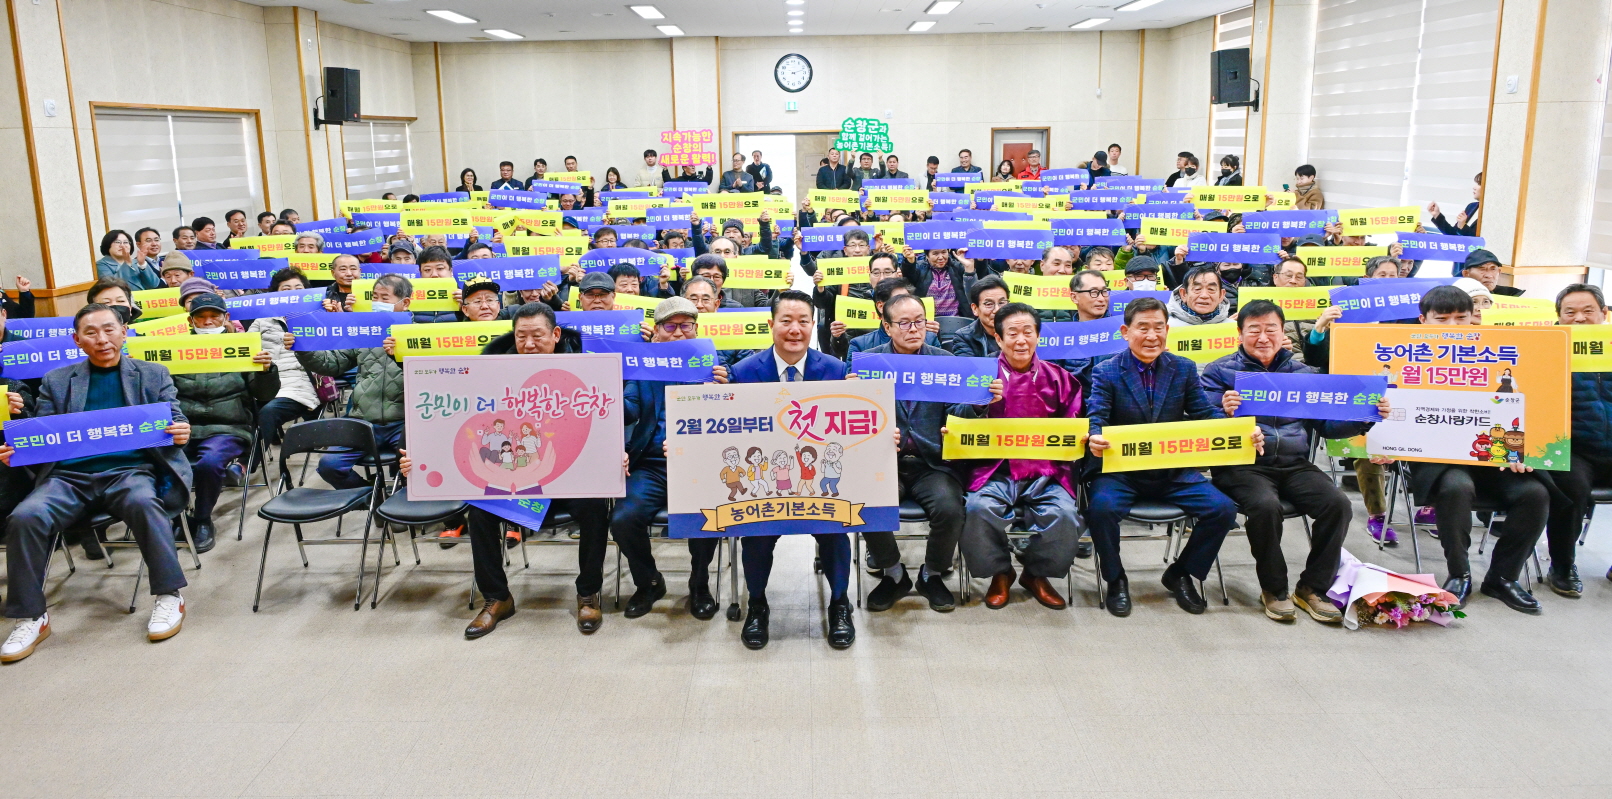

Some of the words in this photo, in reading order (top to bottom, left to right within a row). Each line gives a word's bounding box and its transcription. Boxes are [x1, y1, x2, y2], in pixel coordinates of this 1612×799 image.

[844, 119, 886, 134] 순창군과
[662, 131, 712, 142] 지속가능한
[842, 132, 856, 141] 함께
[858, 133, 887, 142] 걸어가는
[673, 142, 702, 153] 순창의
[836, 140, 891, 151] 농어촌기본소득!
[660, 154, 689, 164] 새로운
[692, 153, 714, 164] 활력!
[1350, 218, 1367, 226] 매월
[1370, 216, 1414, 225] 15만원으로
[906, 232, 929, 240] 군민이
[943, 231, 967, 240] 행복한
[1150, 227, 1167, 236] 매월
[968, 239, 992, 247] 군민이
[996, 240, 1004, 248] 더
[1008, 240, 1034, 249] 행복한
[1190, 243, 1217, 252] 군민이
[1220, 244, 1229, 252] 더
[1232, 244, 1260, 253] 행복한
[1402, 240, 1426, 249] 군민이
[1429, 242, 1438, 250] 더
[512, 246, 530, 256] 매월
[533, 246, 583, 256] 15만원으로
[1307, 257, 1326, 266] 매월
[205, 271, 227, 280] 군민이
[230, 271, 238, 279] 더
[240, 270, 267, 279] 행복한
[491, 271, 500, 279] 더
[504, 269, 534, 279] 행복한
[537, 268, 558, 278] 순창
[733, 269, 782, 278] 15만원으로
[826, 267, 844, 276] 매월
[1013, 285, 1032, 297] 매월
[226, 299, 252, 309] 군민이
[269, 295, 300, 305] 행복한
[302, 293, 323, 302] 순창
[1338, 296, 1370, 311] 군민이
[1374, 296, 1385, 307] 더
[847, 308, 867, 320] 매월
[36, 329, 45, 338] 더
[292, 326, 328, 337] 군민이
[332, 327, 342, 336] 더
[347, 325, 382, 336] 행복한
[581, 325, 615, 335] 행복한
[619, 324, 642, 335] 순창
[703, 323, 770, 336] 15만원으로
[407, 337, 431, 350] 매월
[435, 334, 500, 348] 15만원으
[1064, 336, 1074, 346] 더
[1078, 332, 1110, 345] 행복한
[1178, 339, 1202, 352] 매월
[1573, 341, 1604, 355] 매월
[3, 352, 43, 366] 군민이
[48, 350, 61, 361] 더
[145, 349, 172, 362] 매월
[178, 346, 250, 360] 15만원으로
[1374, 343, 1433, 363] 농어촌
[1438, 345, 1518, 366] 기본소득
[626, 356, 638, 367] 더
[642, 357, 682, 368] 행복한
[688, 354, 715, 368] 순창
[903, 372, 915, 384] 더
[920, 372, 962, 386] 행복한
[966, 374, 994, 388] 순창
[1402, 365, 1422, 385] 월
[1425, 366, 1488, 387] 15만원
[416, 392, 468, 420] 군민이
[477, 397, 495, 412] 더
[502, 387, 569, 420] 행복한
[571, 386, 615, 418] 순창
[1240, 390, 1281, 402] 군민이
[1286, 391, 1299, 403] 더
[1306, 392, 1348, 404] 행복한
[1353, 393, 1382, 405] 순창
[676, 419, 702, 435] 2월
[706, 416, 774, 434] 26일부터
[788, 400, 825, 441] 첫
[825, 410, 878, 435] 지급!
[1415, 414, 1491, 426] 순창사랑카드
[14, 433, 61, 448] 군민이
[67, 430, 82, 442] 더
[87, 424, 133, 440] 행복한
[139, 419, 169, 433] 순창
[960, 434, 990, 446] 매월
[996, 434, 1076, 447] 15만원으로
[1122, 442, 1152, 456] 매월
[1159, 436, 1242, 454] 15만원으로
[730, 502, 836, 521] 농어촌기본소득
